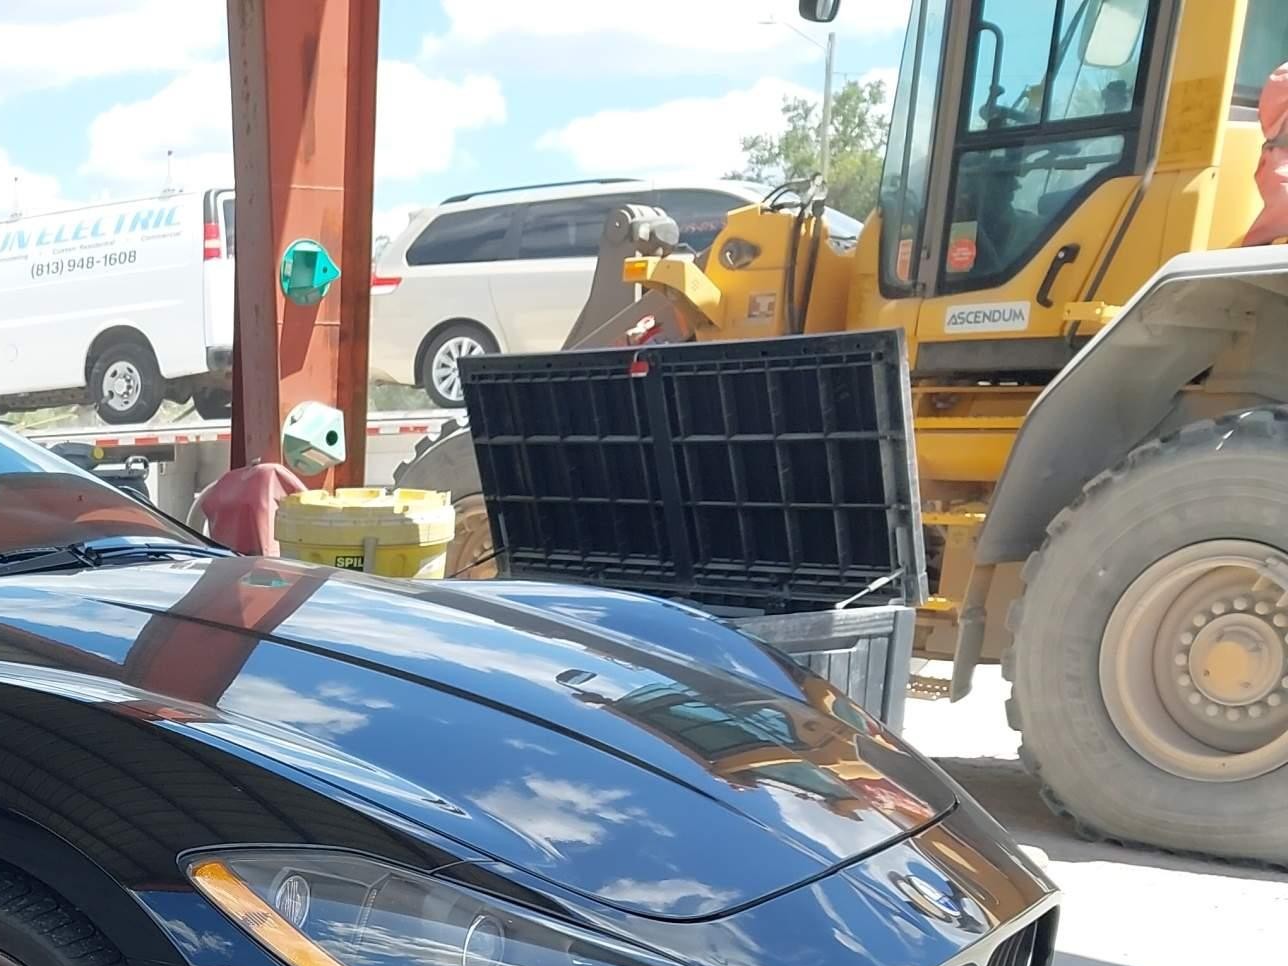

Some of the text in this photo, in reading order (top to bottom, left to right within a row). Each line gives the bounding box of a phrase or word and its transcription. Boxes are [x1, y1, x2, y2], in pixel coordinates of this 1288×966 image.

[36, 206, 181, 247] ELECTRIC
[31, 250, 137, 279] (813) 948-1608
[946, 308, 1025, 326] ASCENDUM
[336, 557, 364, 568] SPIL
